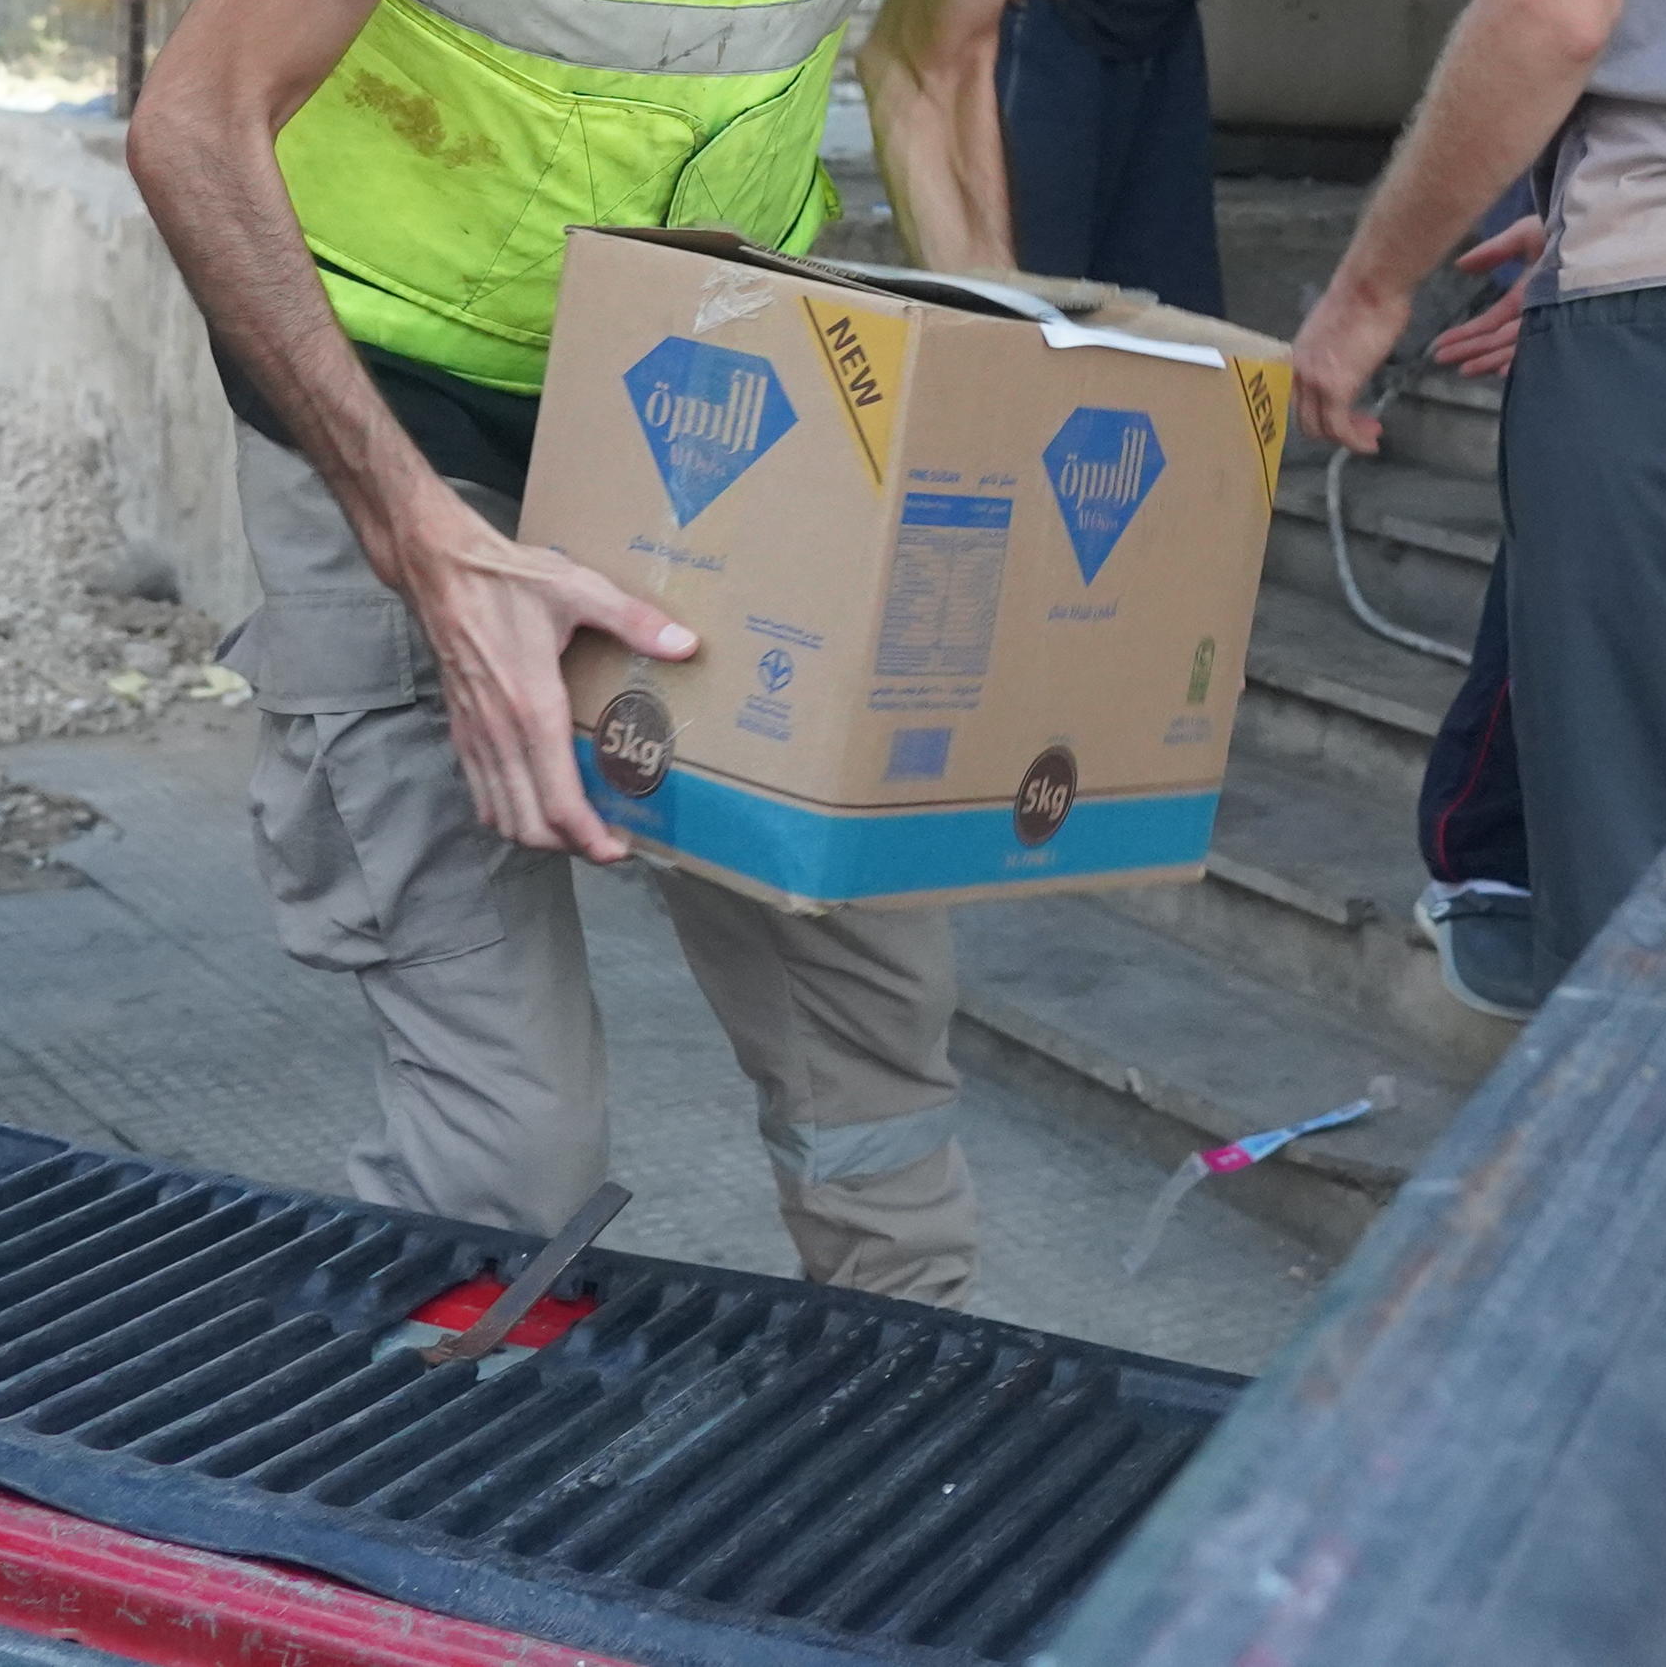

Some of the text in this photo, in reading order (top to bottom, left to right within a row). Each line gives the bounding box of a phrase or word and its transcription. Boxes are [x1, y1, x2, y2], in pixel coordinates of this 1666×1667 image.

[826, 316, 884, 408] NEW
[645, 369, 769, 455] الأسرة
[1248, 368, 1277, 446] NEW
[600, 718, 664, 777] 5kg
[1020, 774, 1071, 822] 5kg
